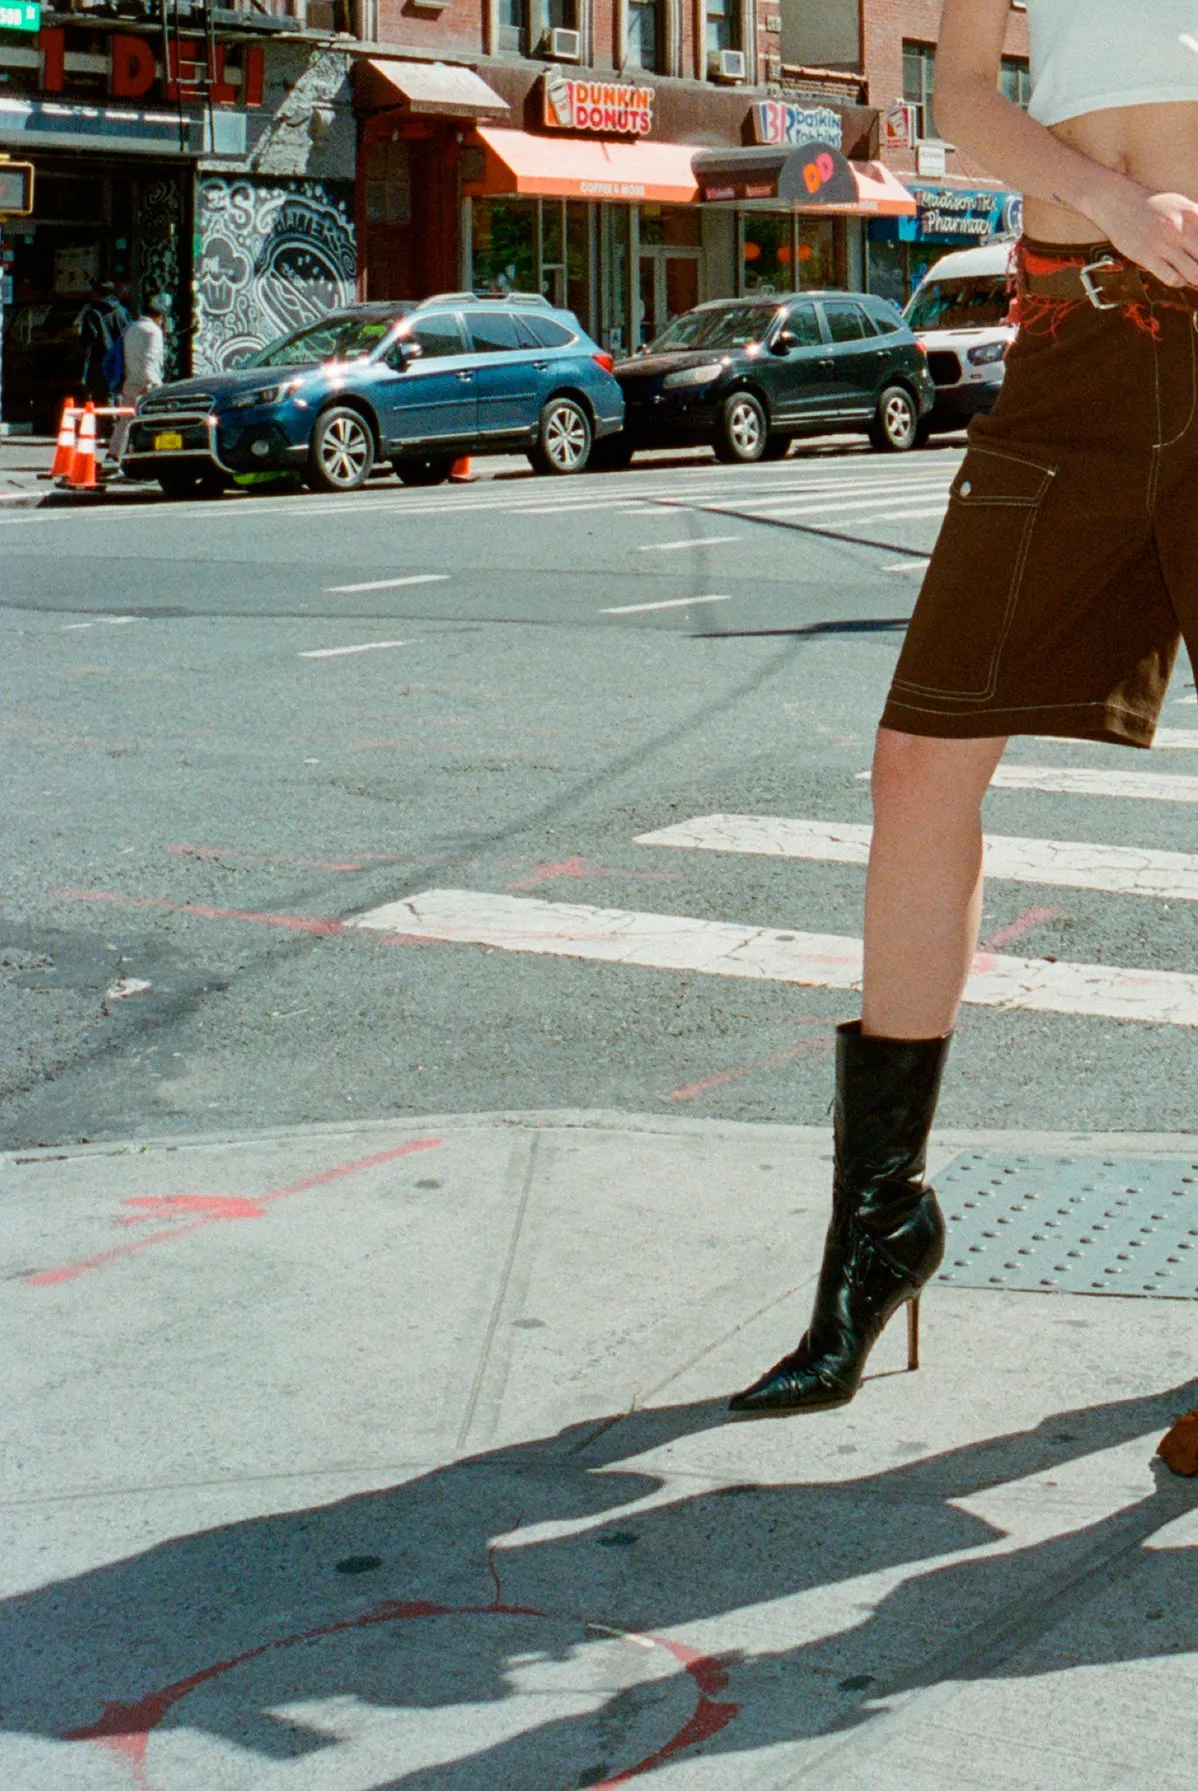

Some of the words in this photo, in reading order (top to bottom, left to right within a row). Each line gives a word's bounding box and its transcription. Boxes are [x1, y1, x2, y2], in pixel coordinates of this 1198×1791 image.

[112, 34, 265, 106] DELI
[576, 82, 655, 109] DUNKIN'
[576, 106, 651, 132] DONUTS
[796, 109, 842, 128] baskin
[921, 189, 977, 211] Madison
[924, 209, 994, 235] Pharmacy
